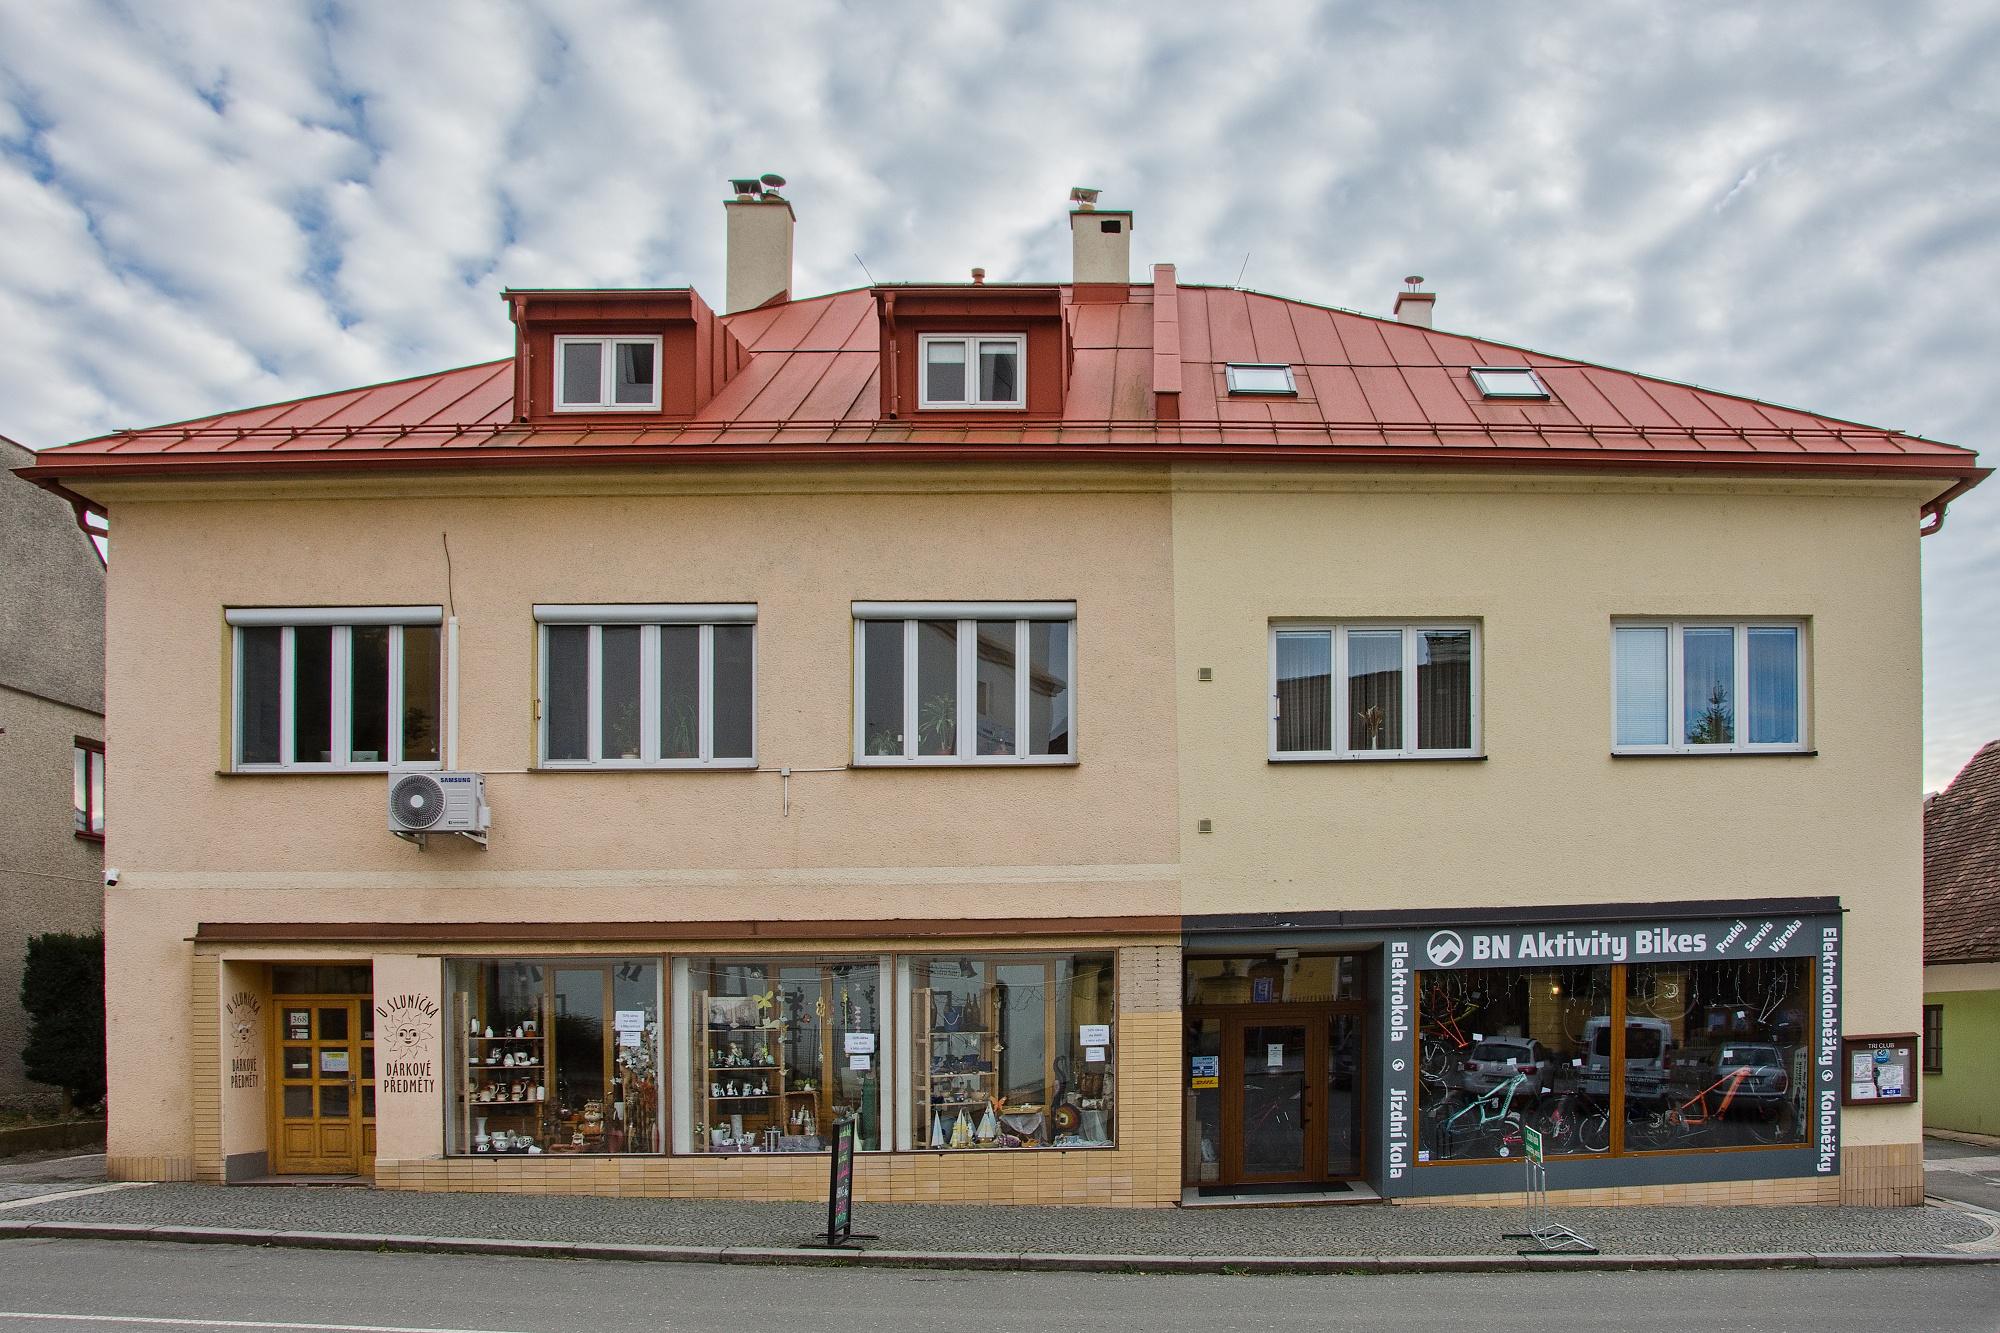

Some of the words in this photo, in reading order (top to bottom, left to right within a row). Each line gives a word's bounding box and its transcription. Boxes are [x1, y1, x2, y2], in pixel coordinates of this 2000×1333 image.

[1472, 935, 1510, 960] BN
[1518, 930, 1627, 961] Aktivity
[1635, 928, 1707, 954] Bikes
[1715, 919, 1747, 954] Prodej
[1744, 921, 1773, 952] Servis
[1768, 919, 1802, 953] Výroba
[226, 1003, 234, 1014] U
[232, 991, 261, 1015] SLUNÍČKA
[375, 1006, 388, 1018] U
[387, 993, 440, 1018] SLUNÍČKA
[1391, 942, 1408, 1042] Elektrokola
[1819, 927, 1838, 1066] Elektrokoloběžky
[230, 1072, 259, 1089] PŘEDMĚTY
[232, 1056, 257, 1072] DÁRKOVÉ
[386, 1060, 432, 1076] DÁRKOVÉ
[384, 1077, 435, 1093] PŘEDMĚTY
[1390, 1088, 1408, 1138] Jízdní
[1817, 1090, 1836, 1172] Koloběžky
[1390, 1142, 1407, 1179] kola
